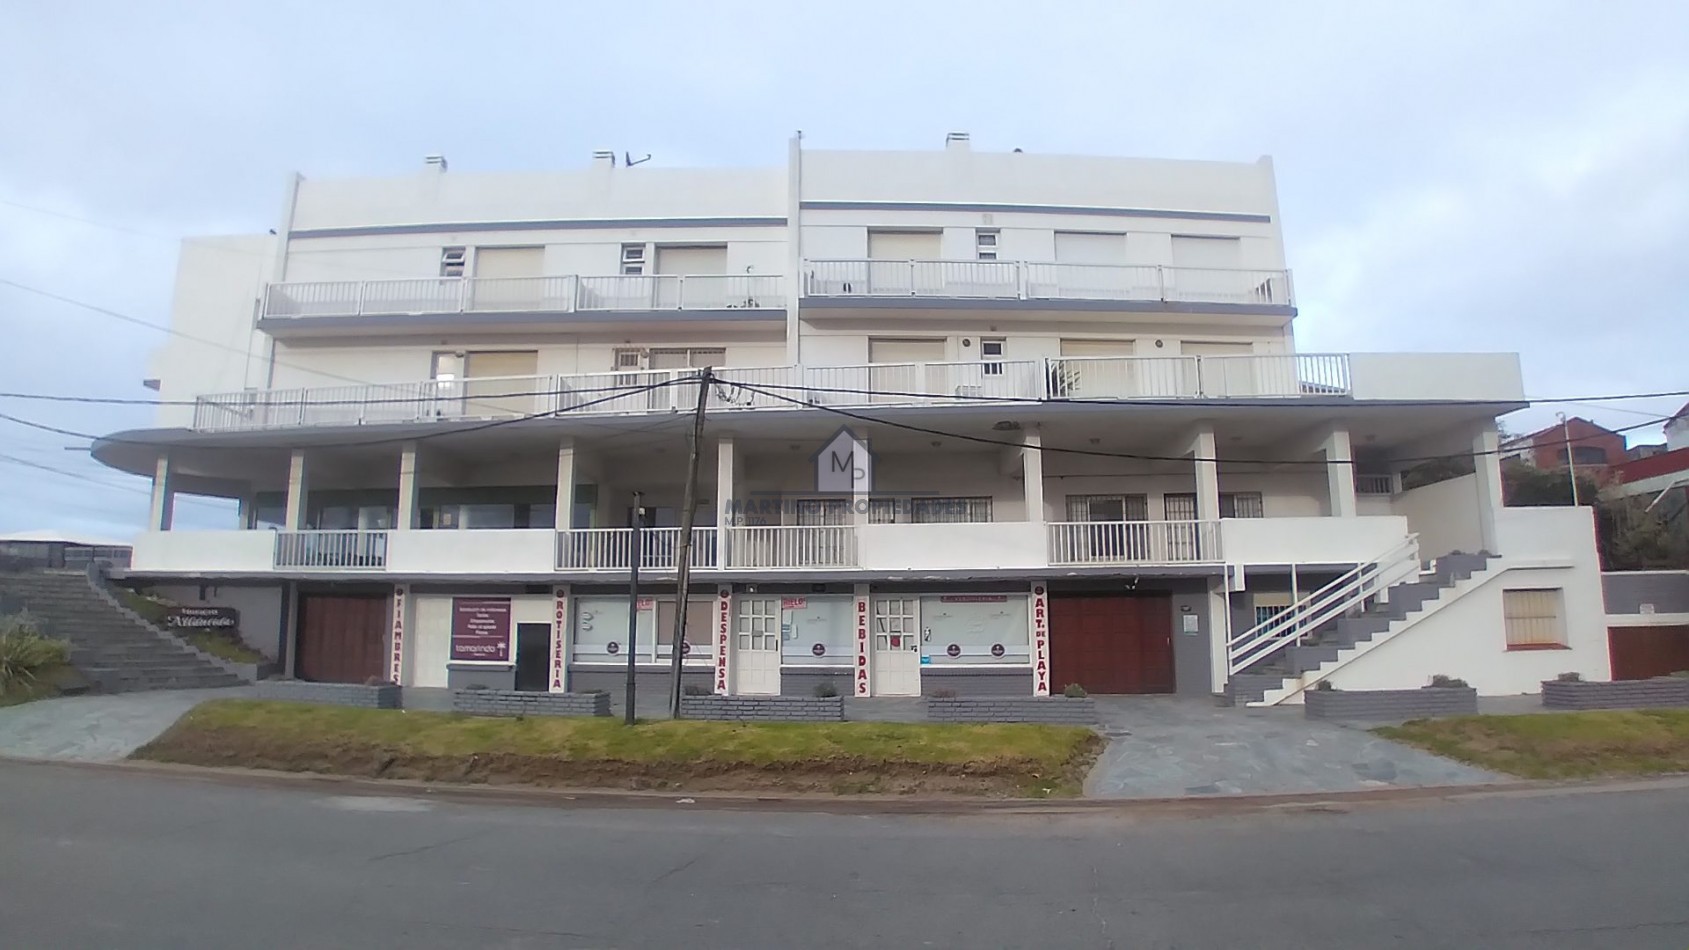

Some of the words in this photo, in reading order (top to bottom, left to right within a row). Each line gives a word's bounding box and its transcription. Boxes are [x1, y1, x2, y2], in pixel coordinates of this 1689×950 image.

[392, 599, 402, 682] FIAMBRES
[553, 600, 563, 688] ROTISERIA
[717, 601, 729, 690] DESPENSA
[858, 602, 868, 693] BEBIDAS
[1037, 640, 1047, 691] PLAYA
